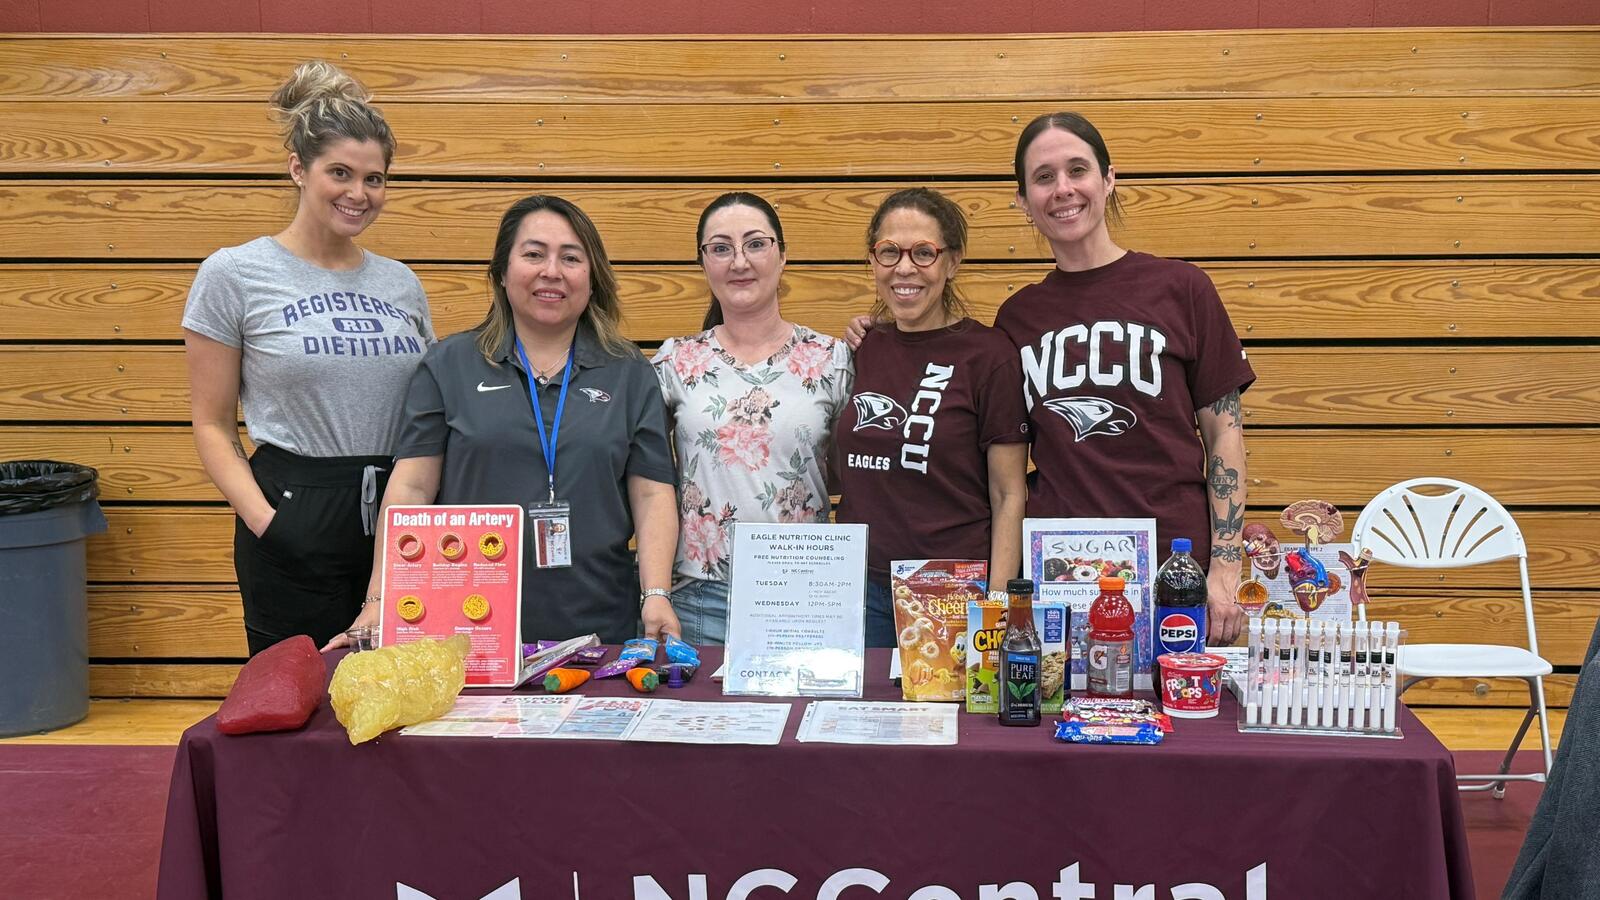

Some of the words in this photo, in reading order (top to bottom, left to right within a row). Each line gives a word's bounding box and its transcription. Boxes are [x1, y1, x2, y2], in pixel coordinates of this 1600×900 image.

[282, 292, 411, 327] REGISTERED
[340, 320, 375, 332] RD
[303, 335, 421, 357] DIETITIAN
[1020, 321, 1166, 414] NCCU
[900, 362, 954, 474] NCCU
[847, 453, 891, 470] EAGLES
[393, 512, 431, 526] Death
[434, 512, 447, 526] of
[450, 514, 465, 526] an
[469, 512, 514, 528] Artery
[1051, 539, 1133, 554] SUGAR
[1041, 588, 1061, 596] How
[1063, 587, 1087, 596] much
[1131, 588, 1139, 596] in
[1161, 628, 1196, 638] PEPSI
[1089, 644, 1108, 670] G
[1011, 663, 1034, 672] PURE
[1011, 672, 1034, 680] LEAF
